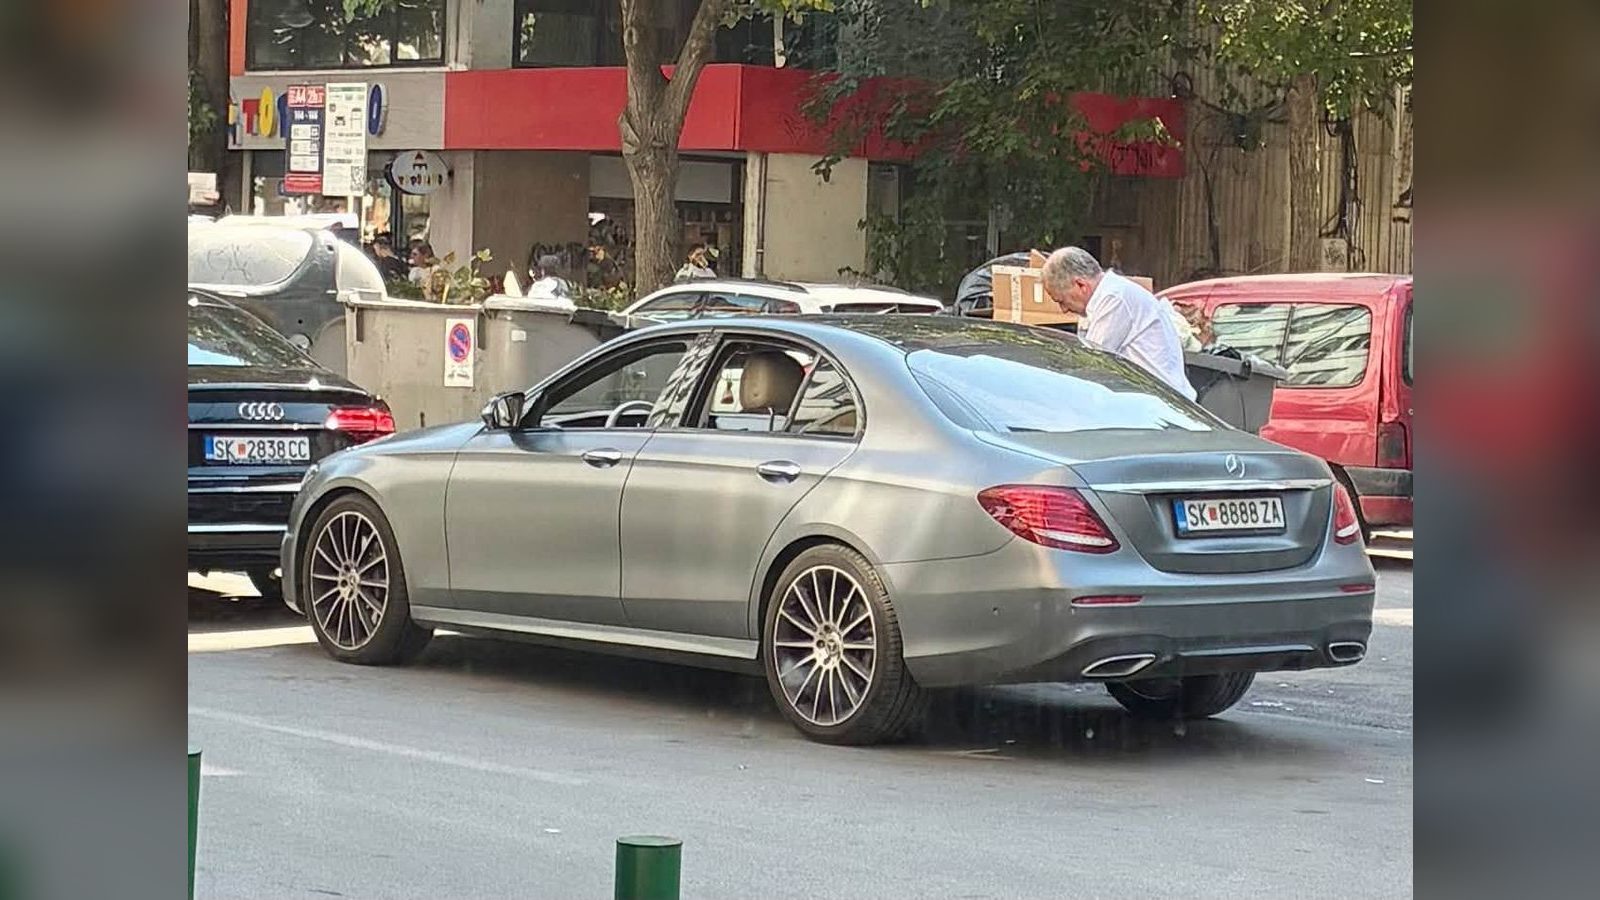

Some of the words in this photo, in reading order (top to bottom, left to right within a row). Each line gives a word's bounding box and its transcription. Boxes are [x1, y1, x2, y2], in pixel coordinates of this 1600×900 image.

[215, 440, 235, 460] SK
[247, 440, 286, 459] 2838
[288, 440, 307, 458] CC
[1188, 503, 1209, 526] SK
[1219, 501, 1259, 525] 8888
[1260, 500, 1282, 523] ZA
